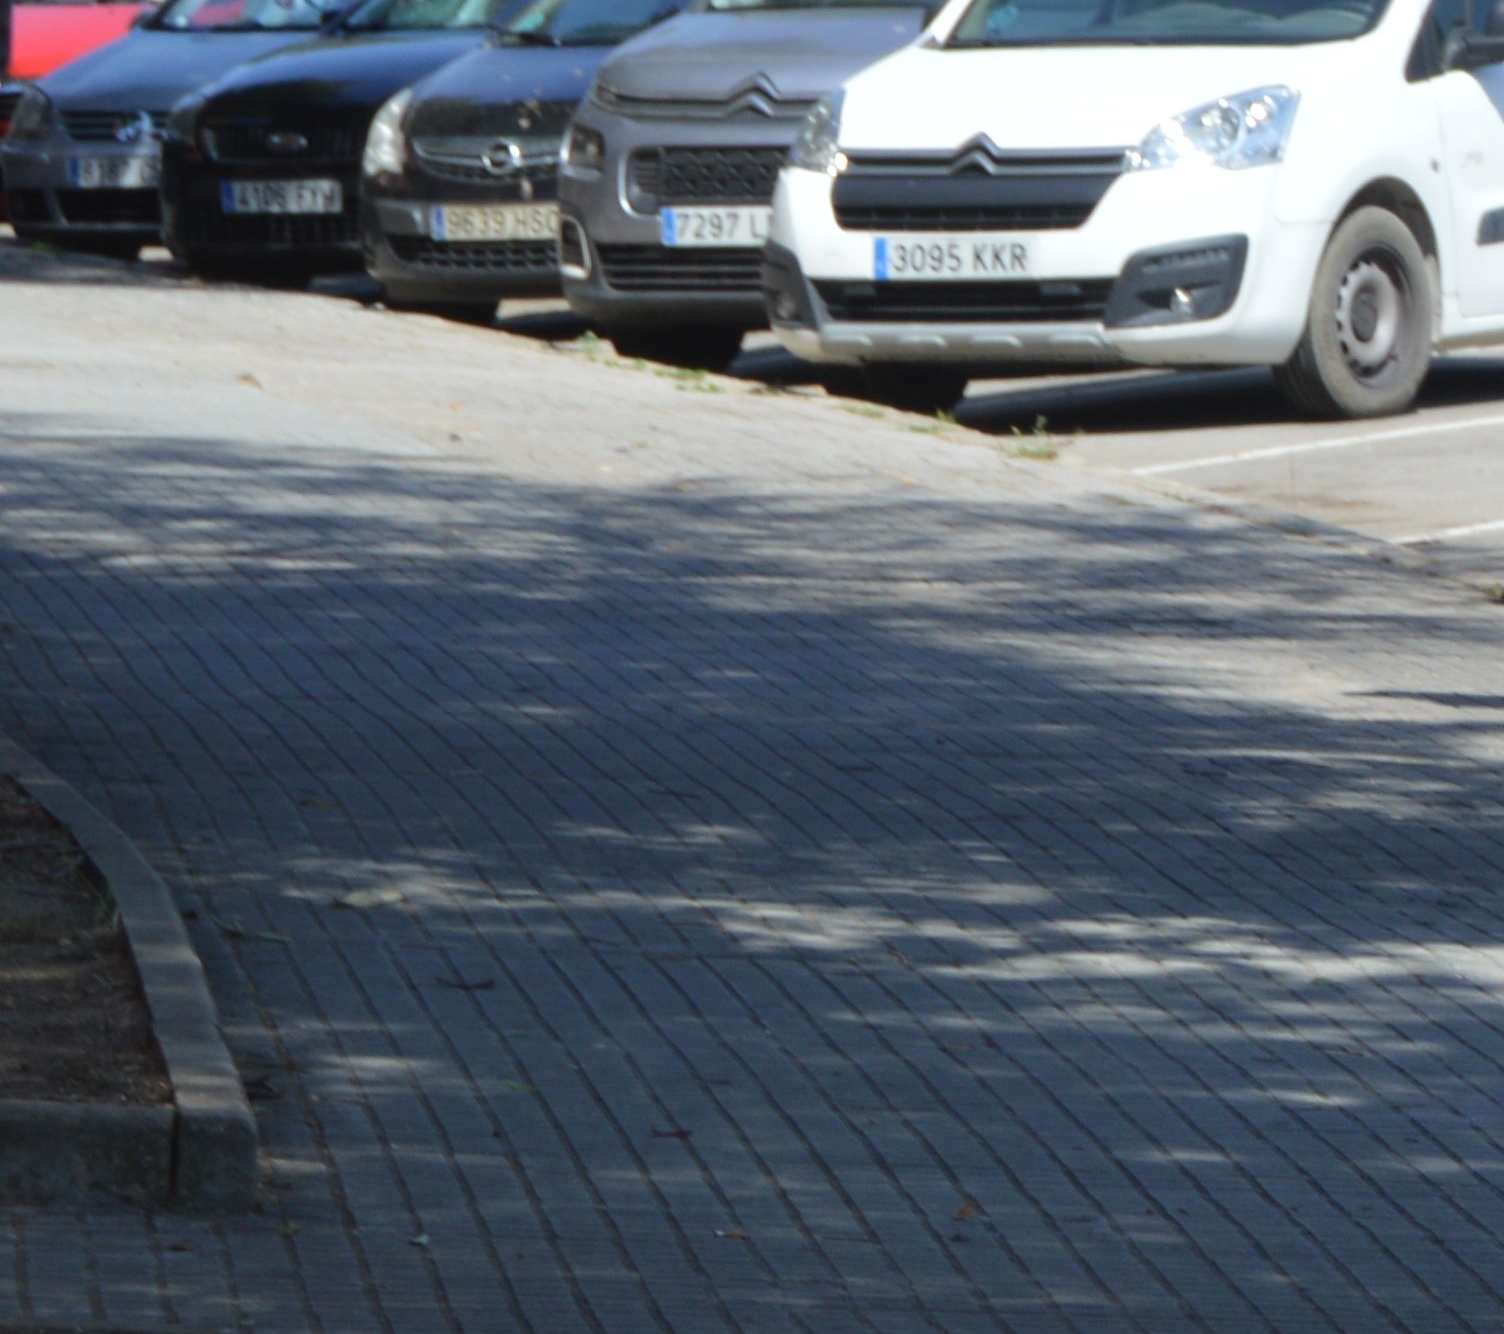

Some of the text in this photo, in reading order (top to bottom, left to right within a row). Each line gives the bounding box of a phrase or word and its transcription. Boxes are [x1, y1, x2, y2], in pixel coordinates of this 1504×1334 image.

[677, 212, 740, 240] 7297
[893, 243, 1028, 272] 3095 KKR
